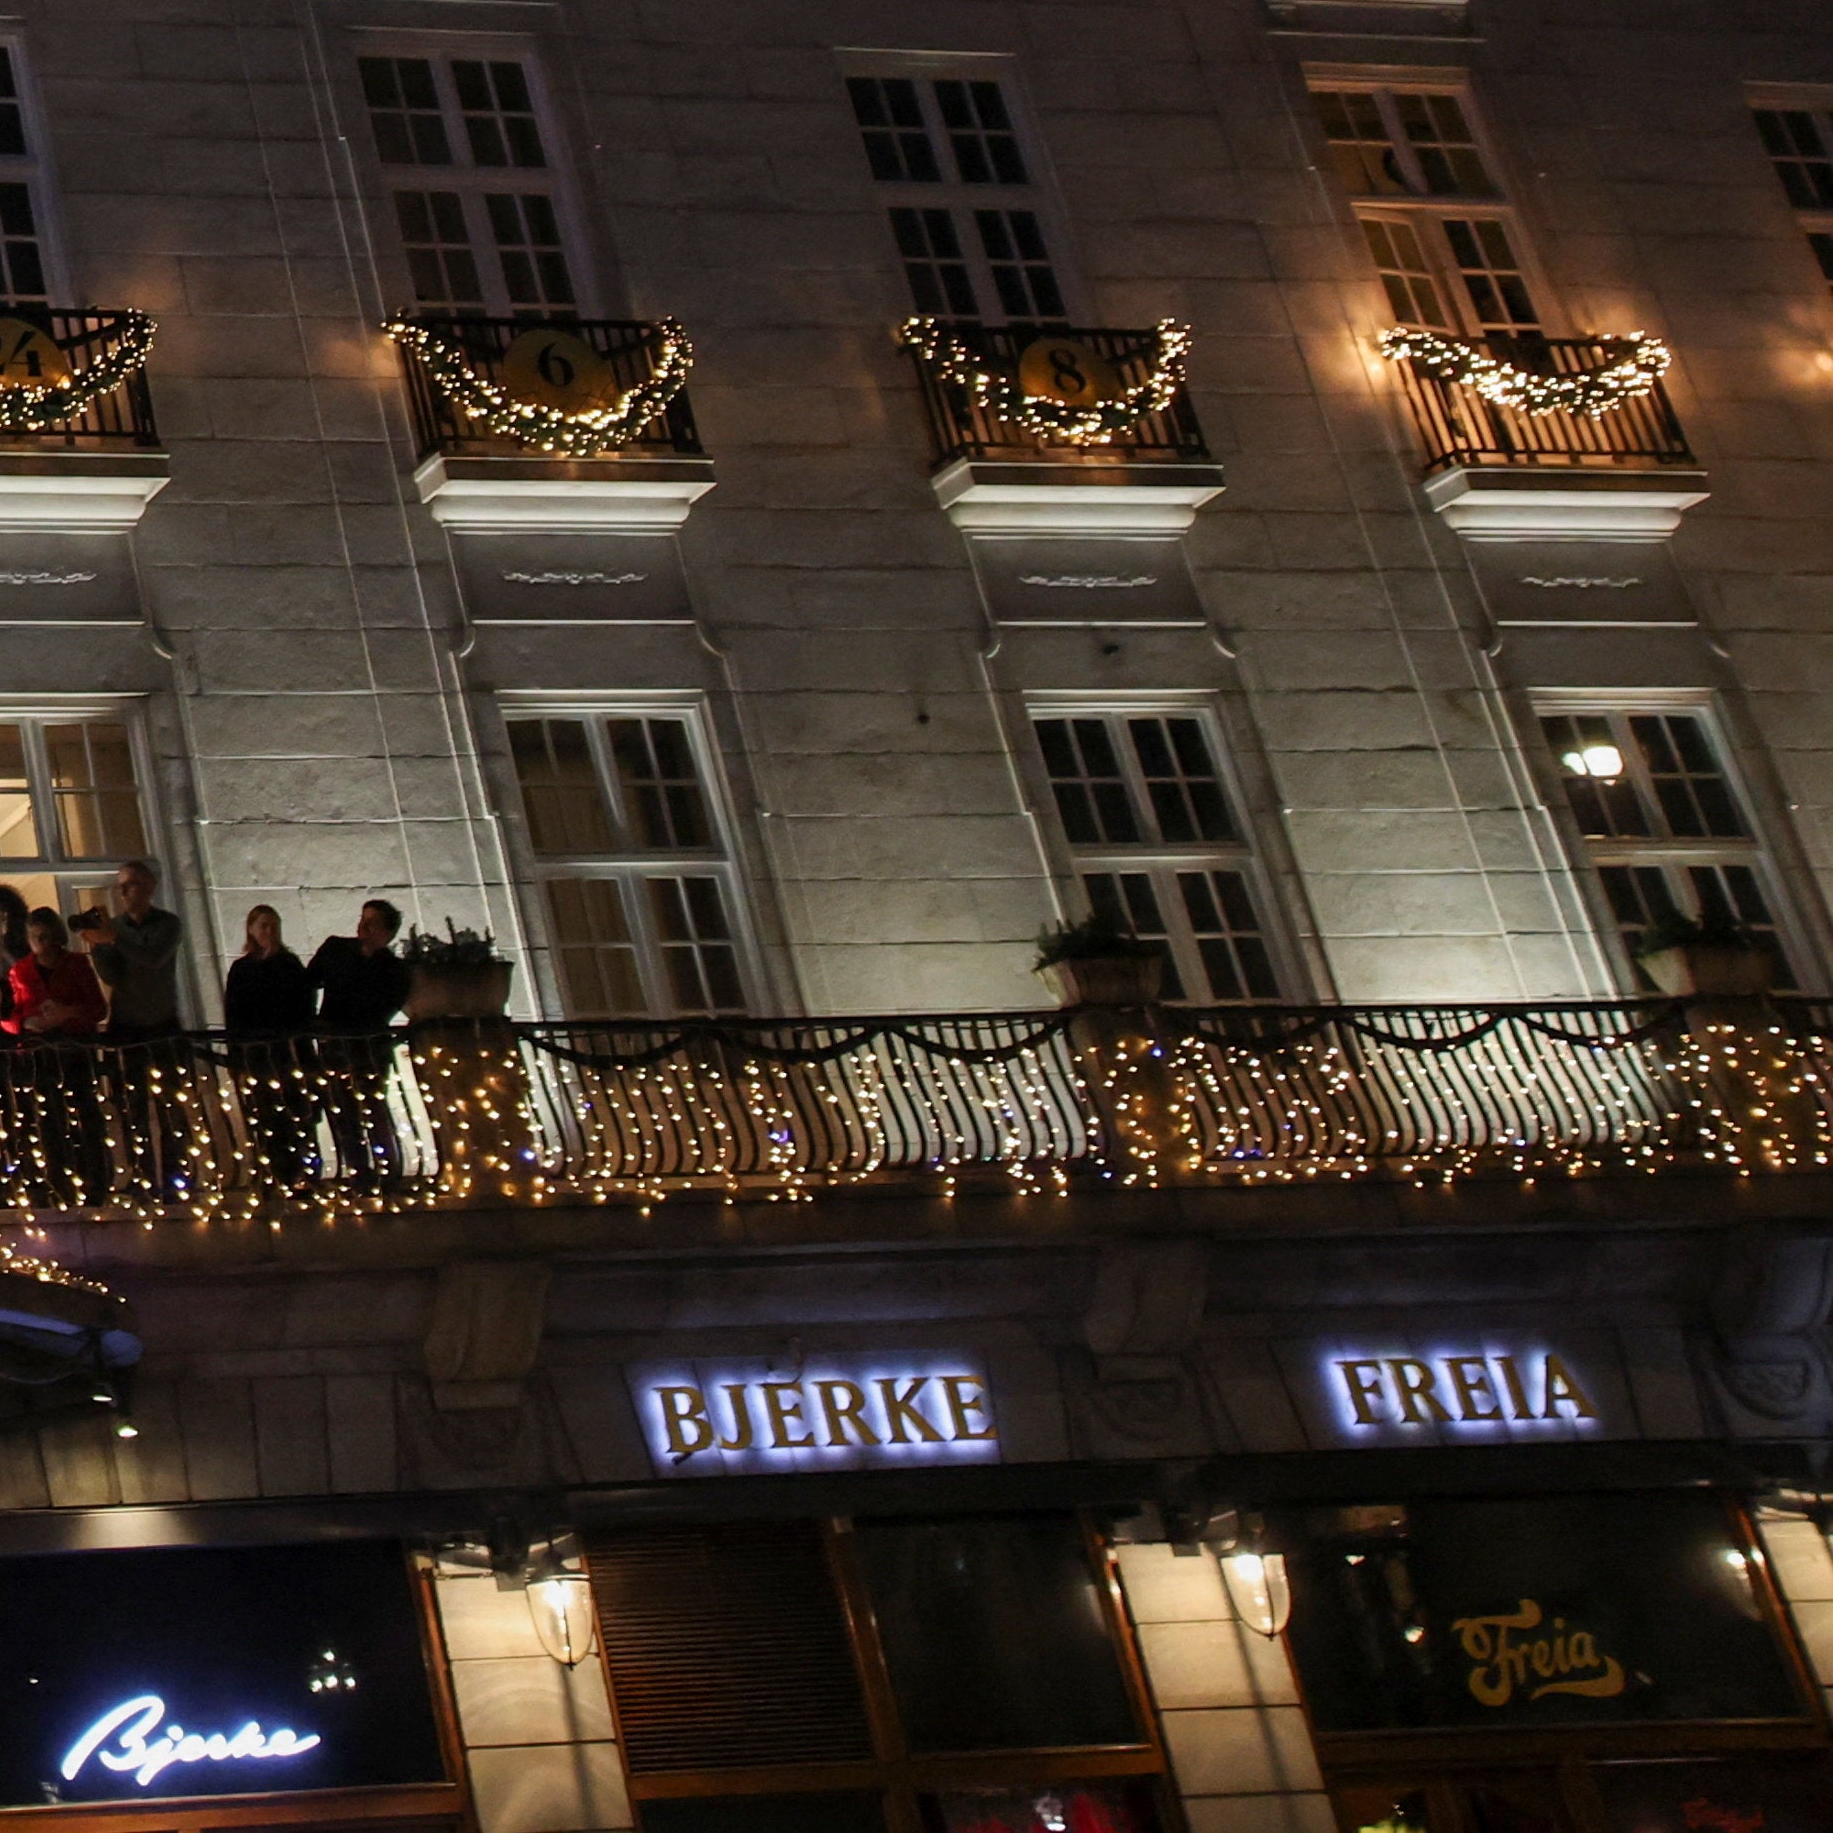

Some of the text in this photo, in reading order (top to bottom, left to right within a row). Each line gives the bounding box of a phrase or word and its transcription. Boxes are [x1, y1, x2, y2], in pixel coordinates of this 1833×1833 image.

[538, 342, 575, 387] 6
[1048, 348, 1087, 394] 8
[651, 1373, 1000, 1455] BJERKE
[1335, 1352, 1601, 1425] FREIA
[1452, 1598, 1627, 1707] Freia
[61, 1695, 321, 1786] Bjerke
